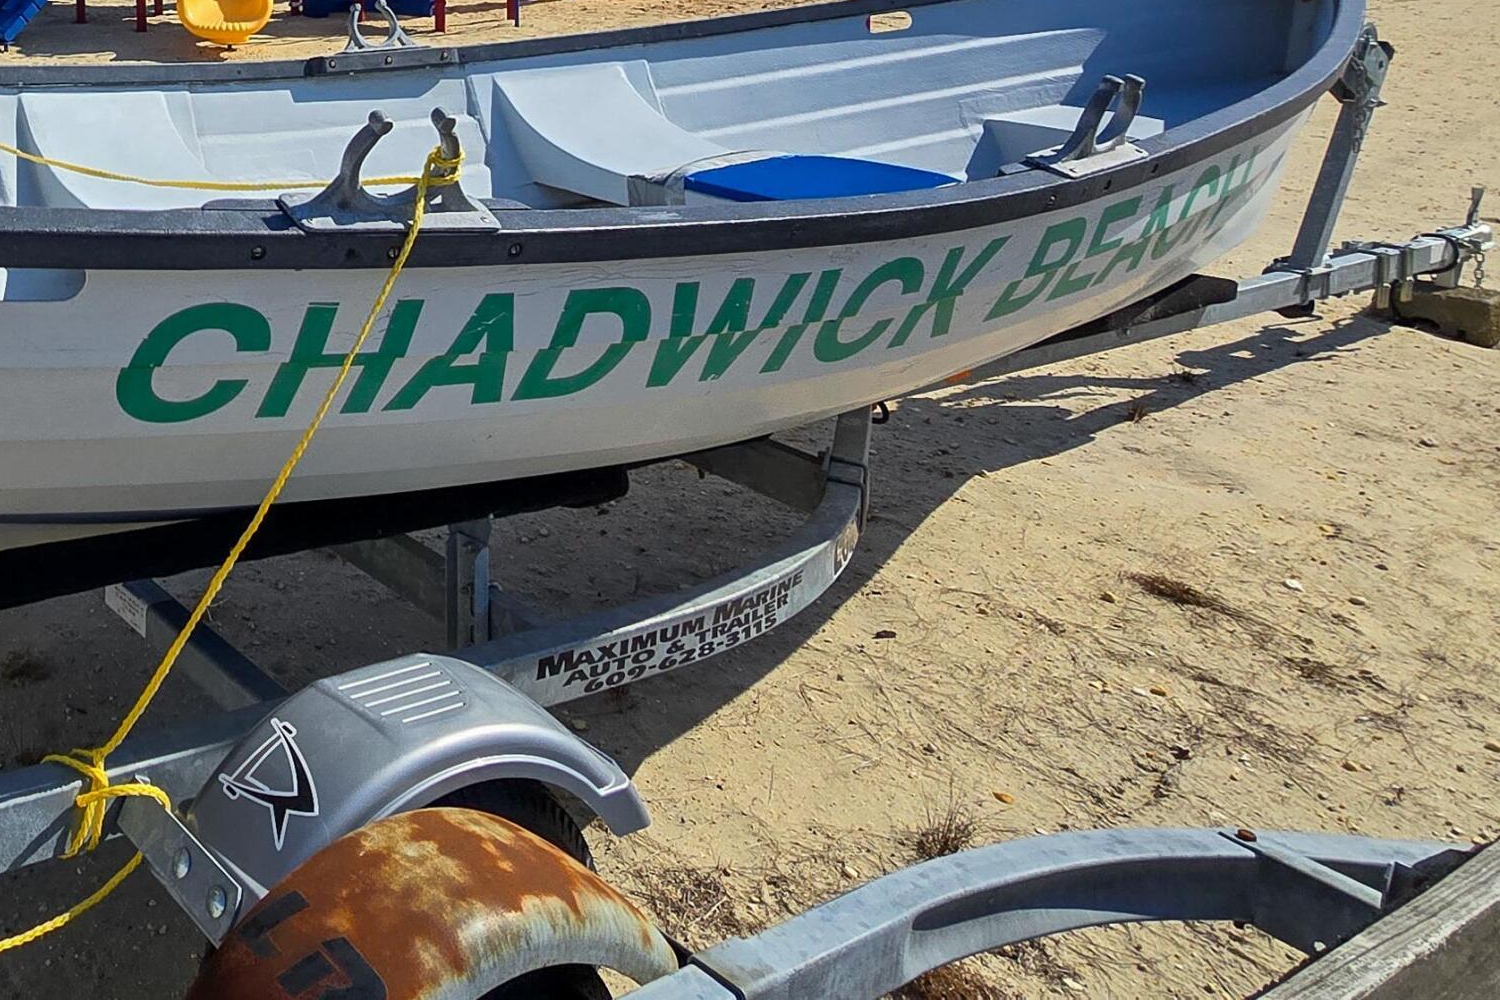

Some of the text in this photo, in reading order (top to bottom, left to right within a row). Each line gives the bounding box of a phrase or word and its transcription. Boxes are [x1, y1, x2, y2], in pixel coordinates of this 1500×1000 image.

[115, 145, 1262, 424] CHADWICK BEACH
[536, 569, 804, 681] MAXIMUM MARINE
[562, 593, 789, 688] AUTO & TRAILER
[583, 613, 777, 693] 609-628-3115
